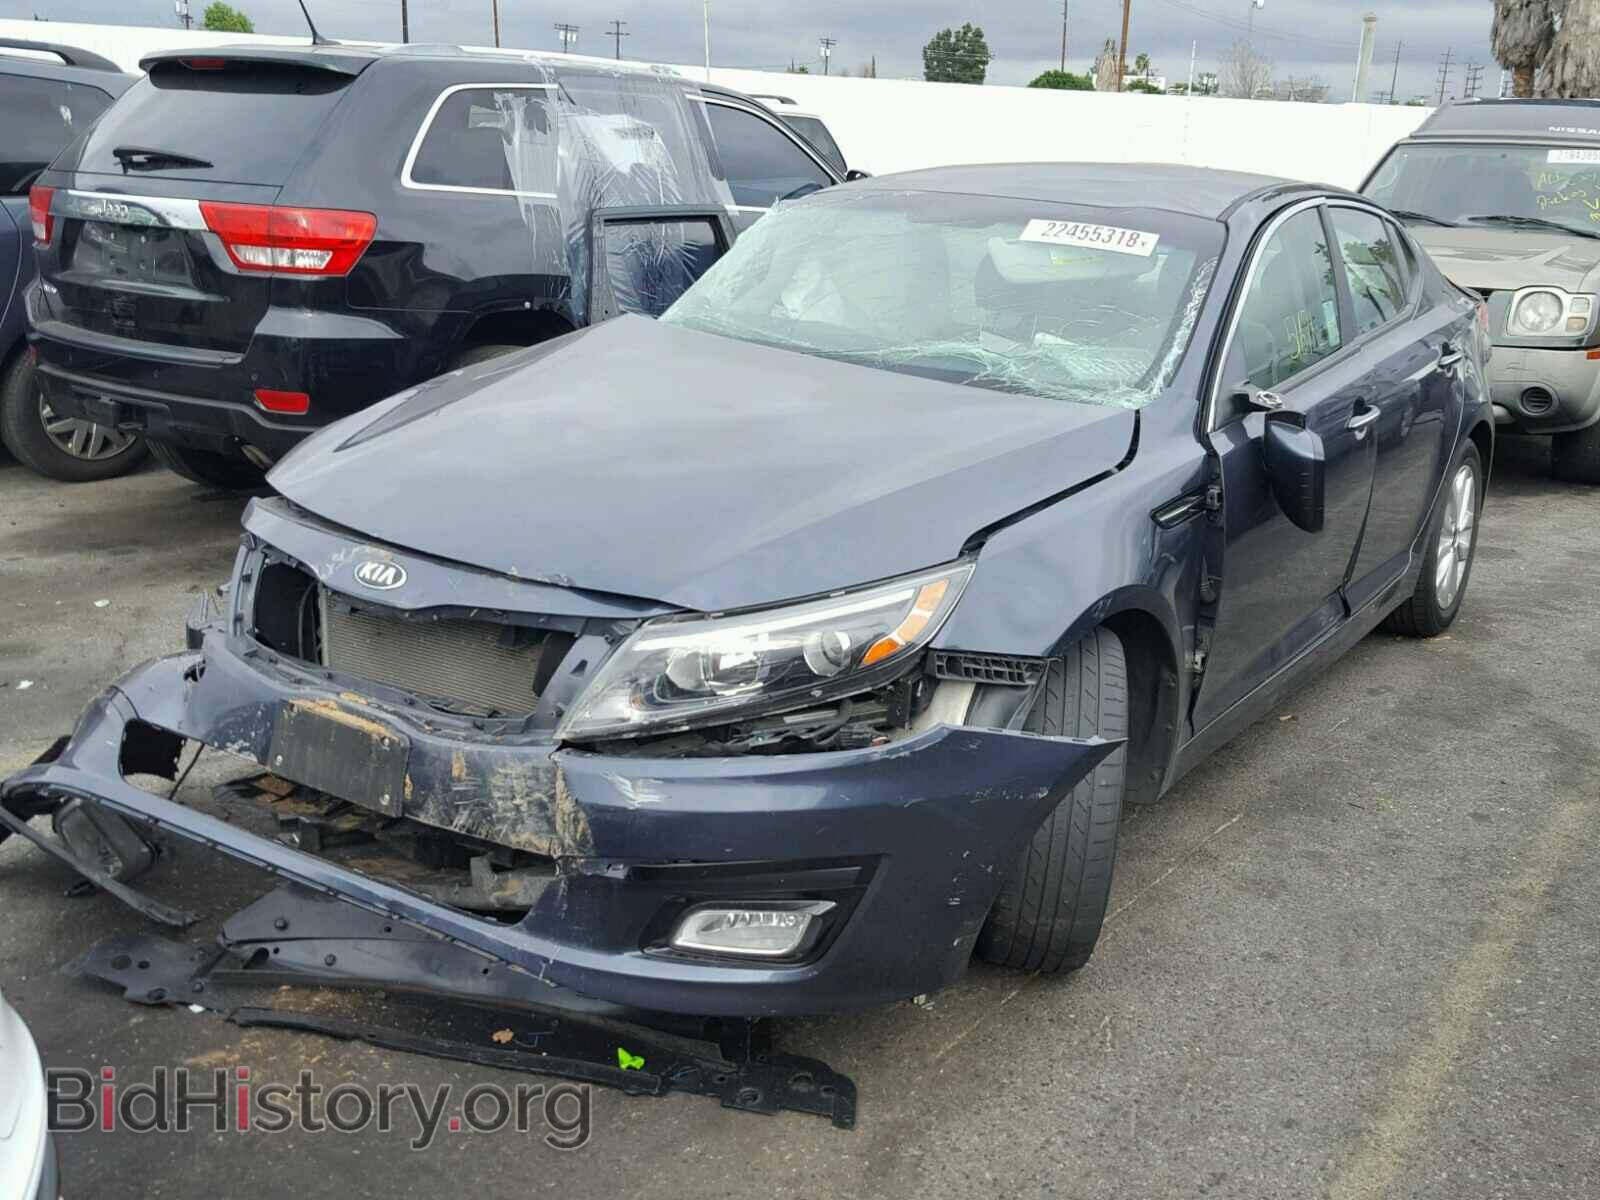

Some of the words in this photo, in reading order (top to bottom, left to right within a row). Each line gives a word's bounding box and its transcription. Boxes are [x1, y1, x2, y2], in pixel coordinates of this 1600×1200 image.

[1547, 125, 1600, 135] NISSA
[1041, 222, 1140, 247] 22455318
[358, 561, 397, 585] KIA
